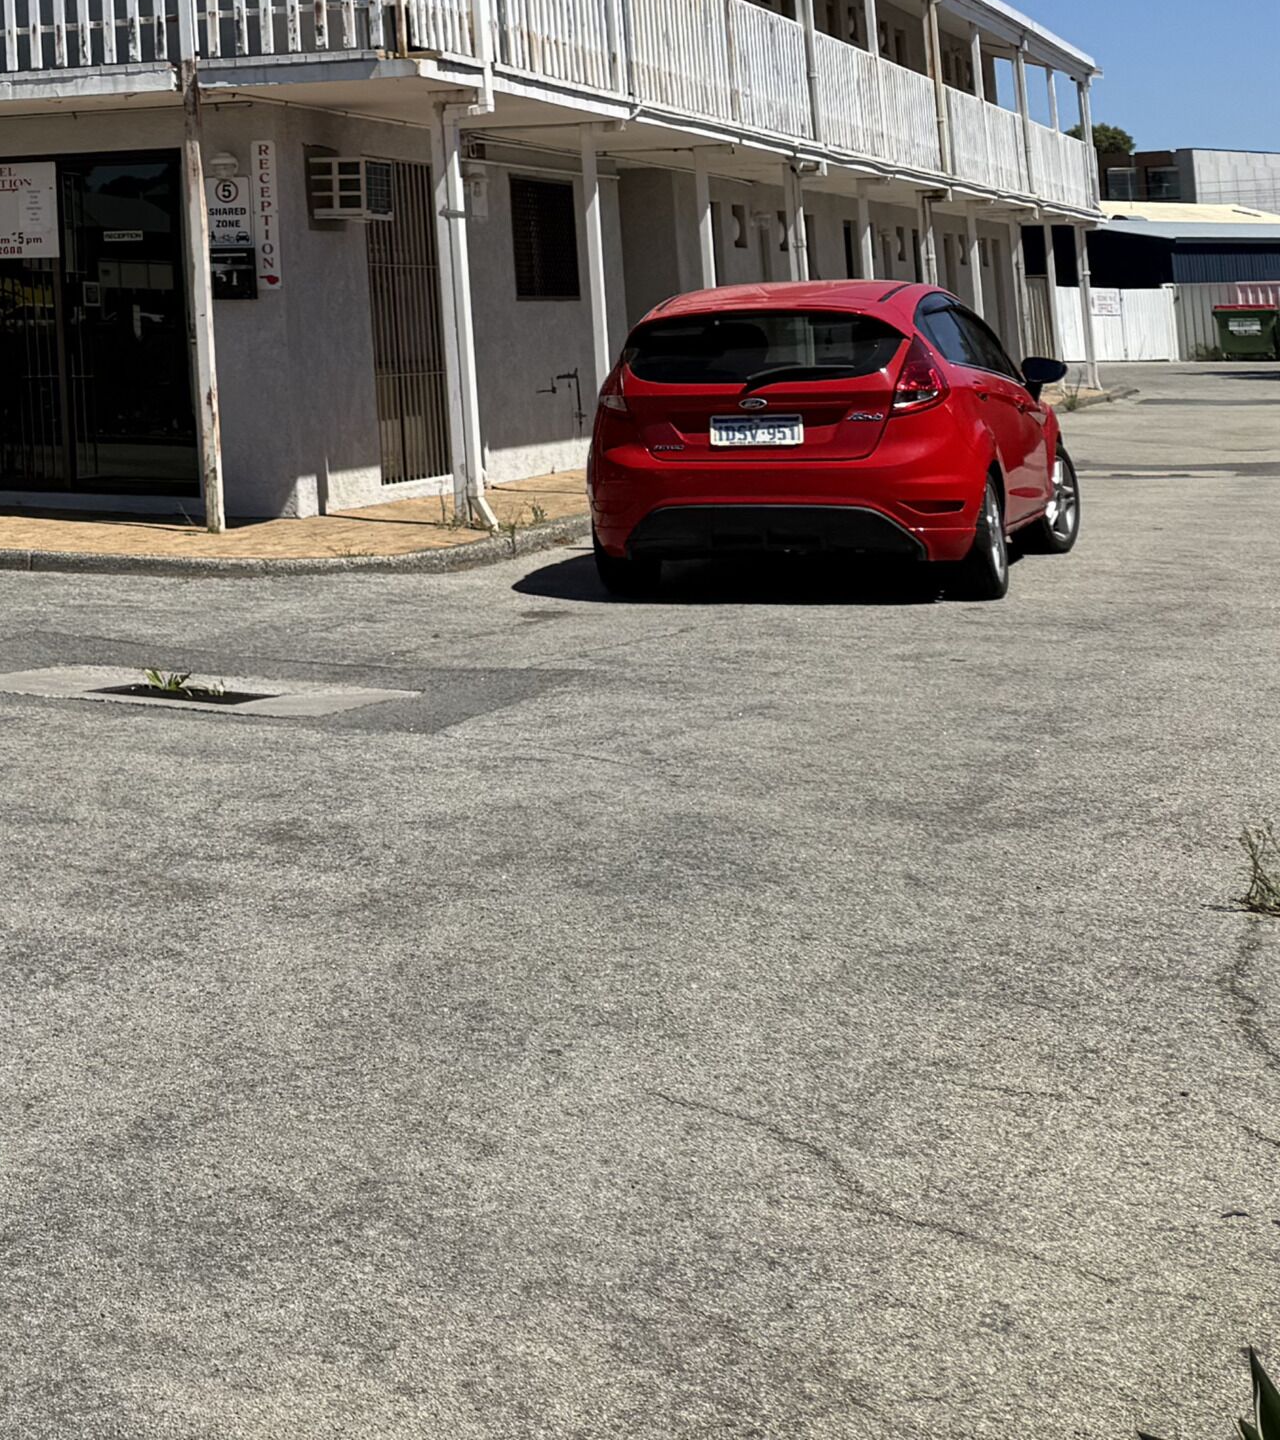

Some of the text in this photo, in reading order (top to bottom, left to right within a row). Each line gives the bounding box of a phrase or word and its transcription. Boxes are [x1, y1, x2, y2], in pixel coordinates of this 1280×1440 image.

[221, 184, 232, 198] 5
[257, 143, 275, 270] RECEPTION
[208, 207, 247, 216] SHARED
[215, 219, 241, 228] ZONE
[25, 237, 43, 246] pm
